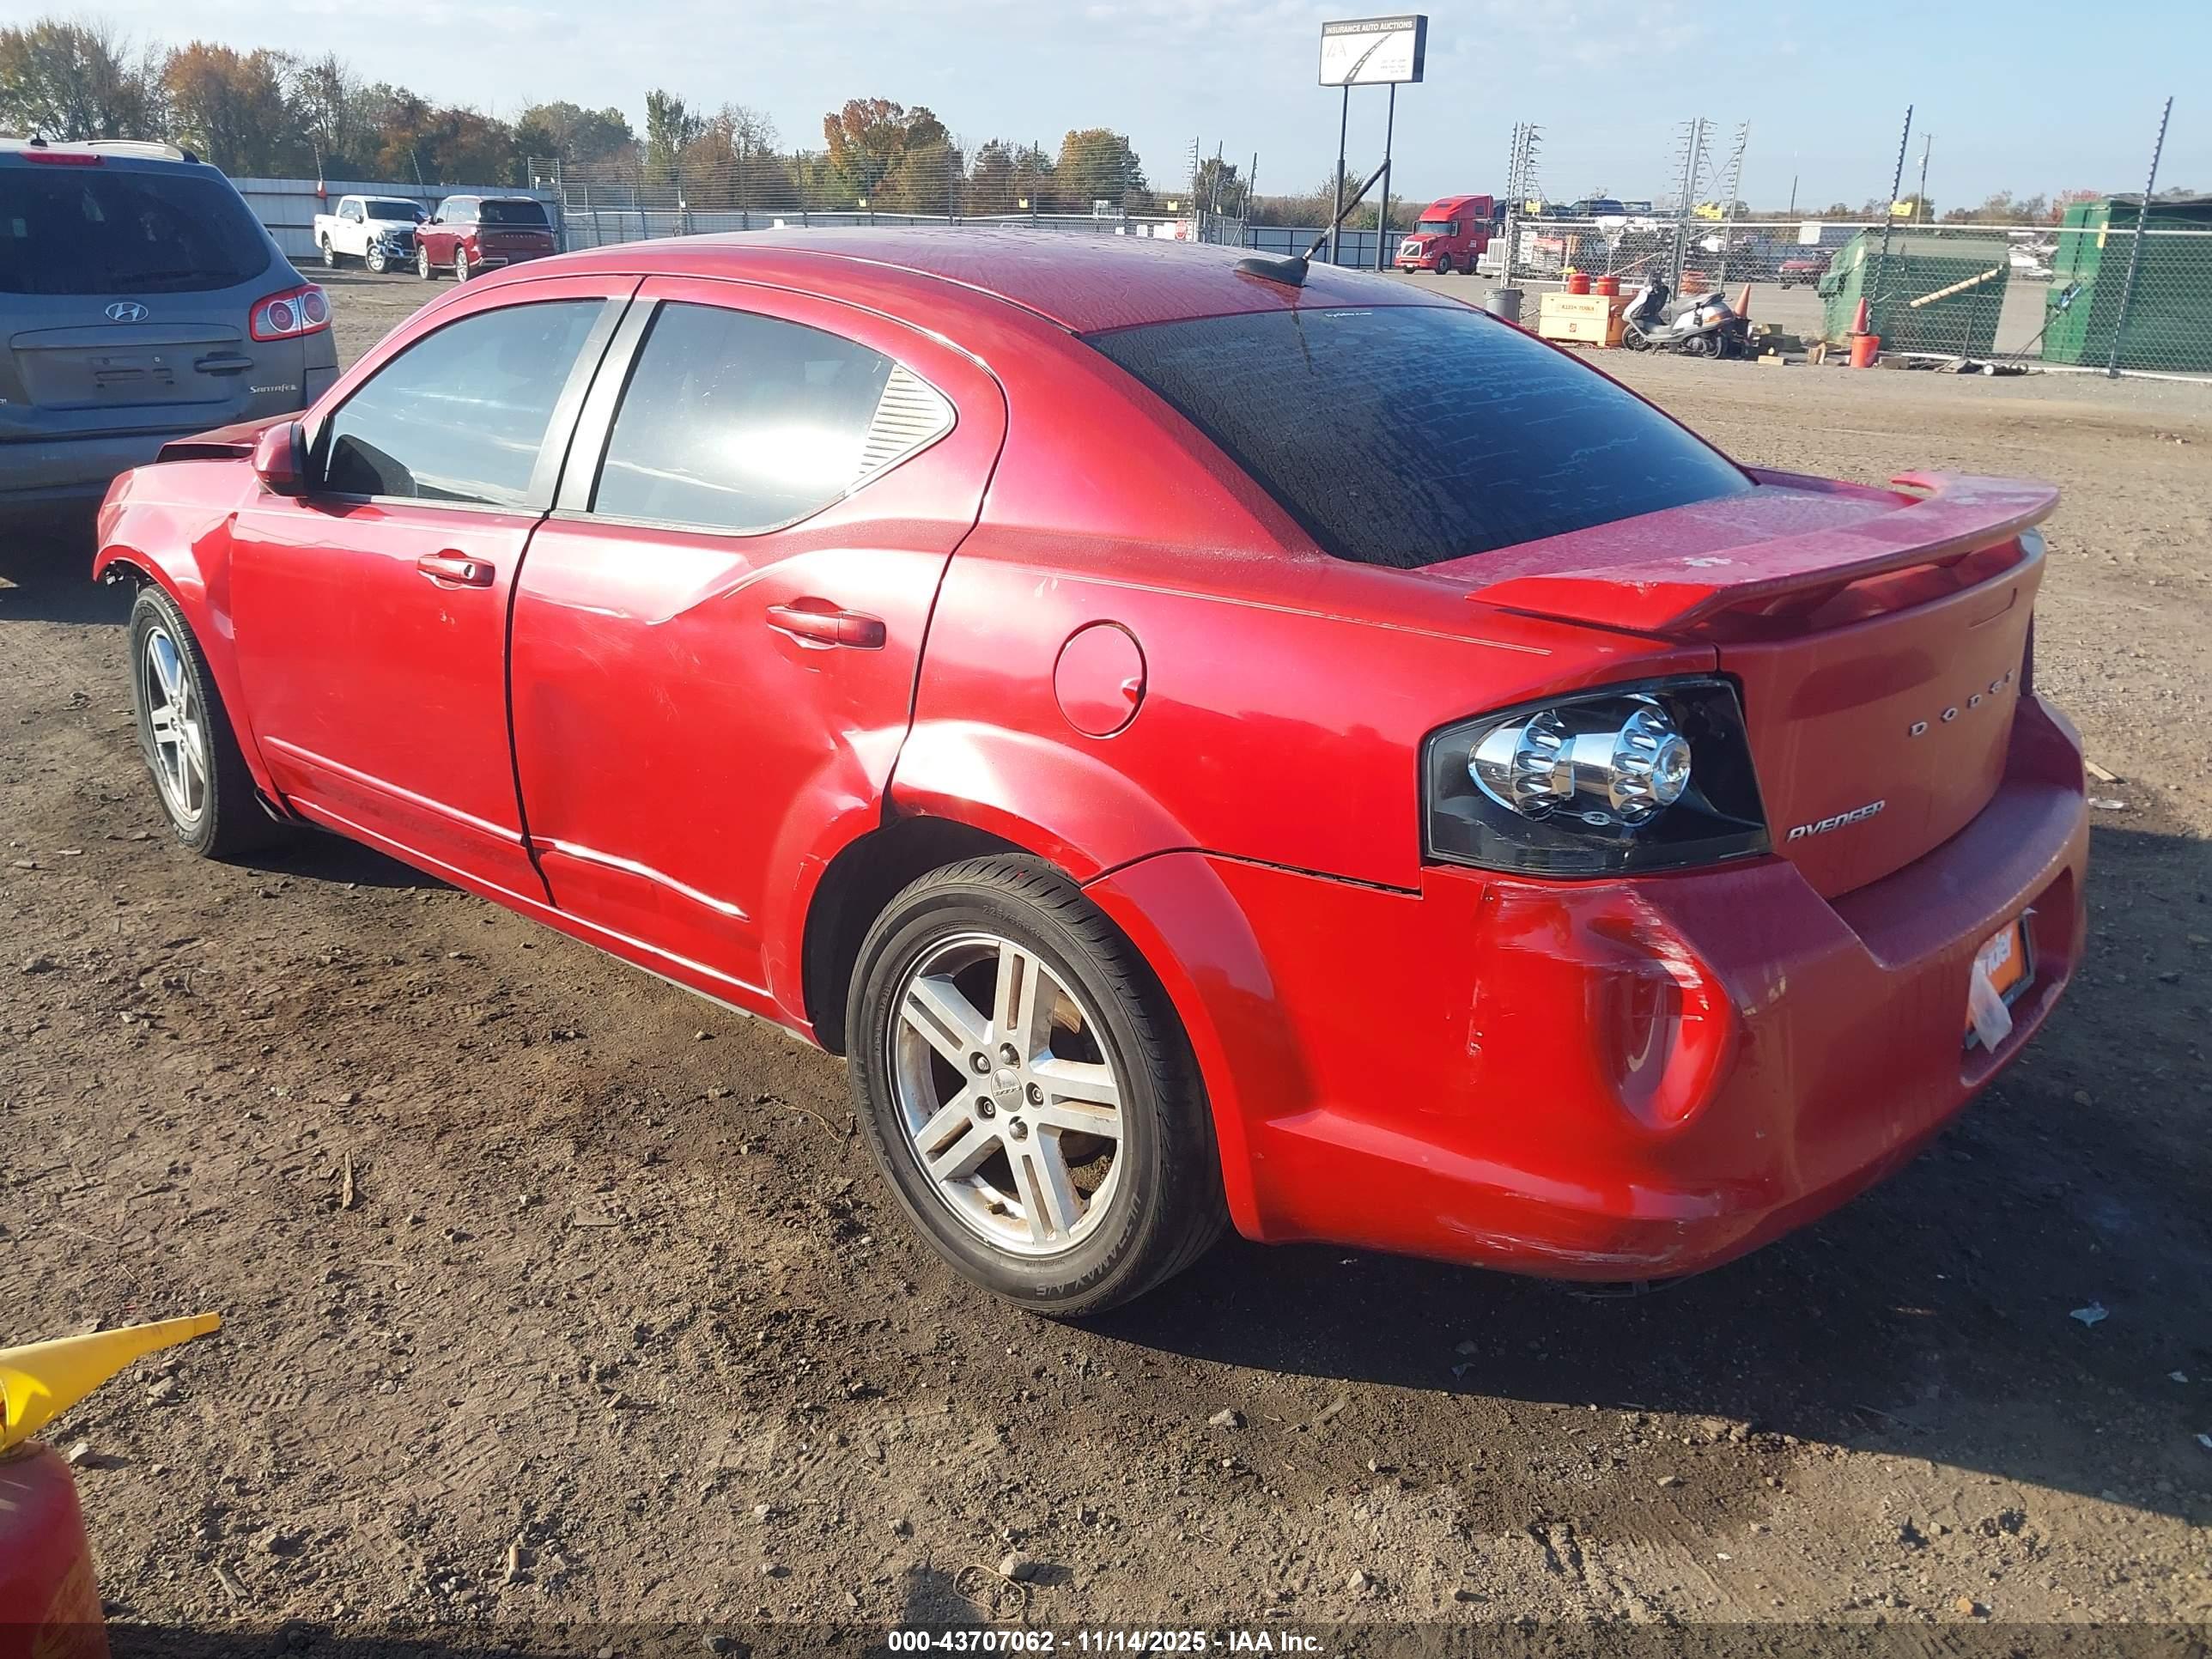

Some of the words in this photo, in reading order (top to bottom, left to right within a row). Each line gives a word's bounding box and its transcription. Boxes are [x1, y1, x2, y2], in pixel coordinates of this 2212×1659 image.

[1326, 26, 1361, 34] INSURANCE
[1361, 23, 1379, 32] AUTO
[1380, 21, 1413, 30] AUCTIONS
[1787, 800, 1886, 842] AVENGER
[1074, 1191, 1141, 1290] ULTRAMAX
[1036, 1283, 1065, 1296] A/S
